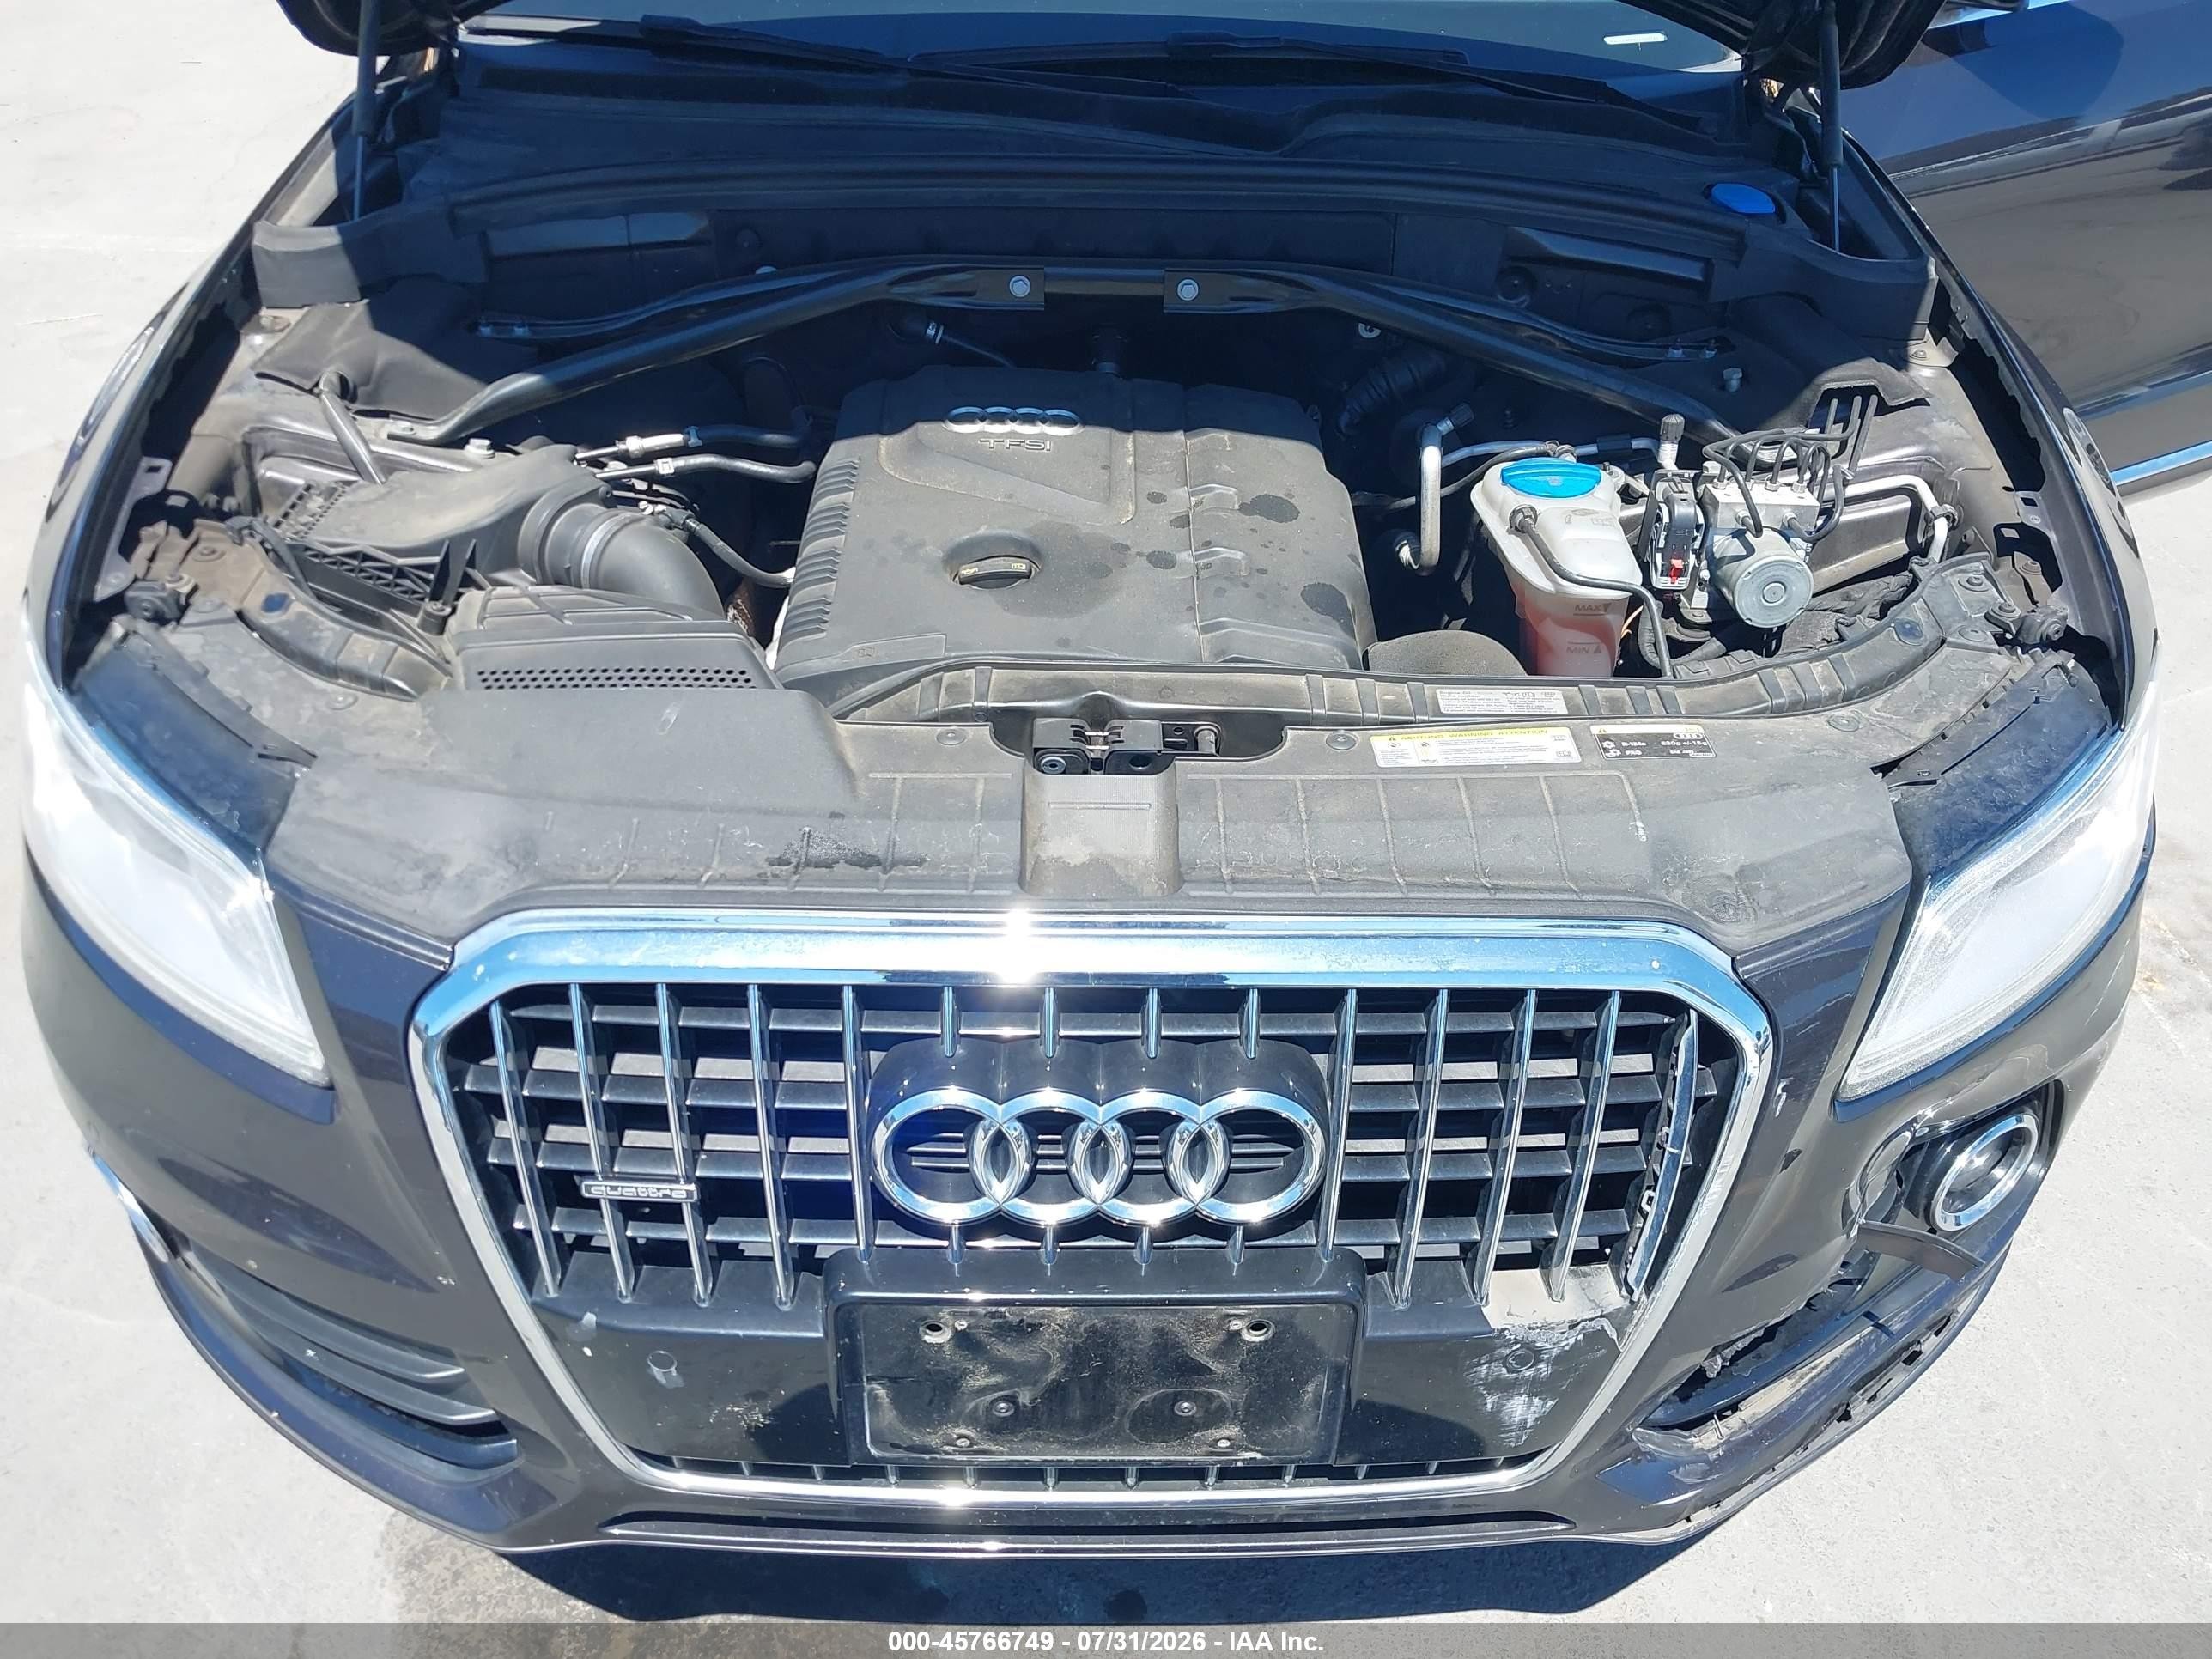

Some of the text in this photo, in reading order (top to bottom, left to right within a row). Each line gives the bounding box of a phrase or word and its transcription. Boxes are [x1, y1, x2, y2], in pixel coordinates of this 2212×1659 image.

[979, 439, 1052, 452] TFSI
[1574, 604, 1601, 612] MAX
[591, 1186, 688, 1199] quattro
